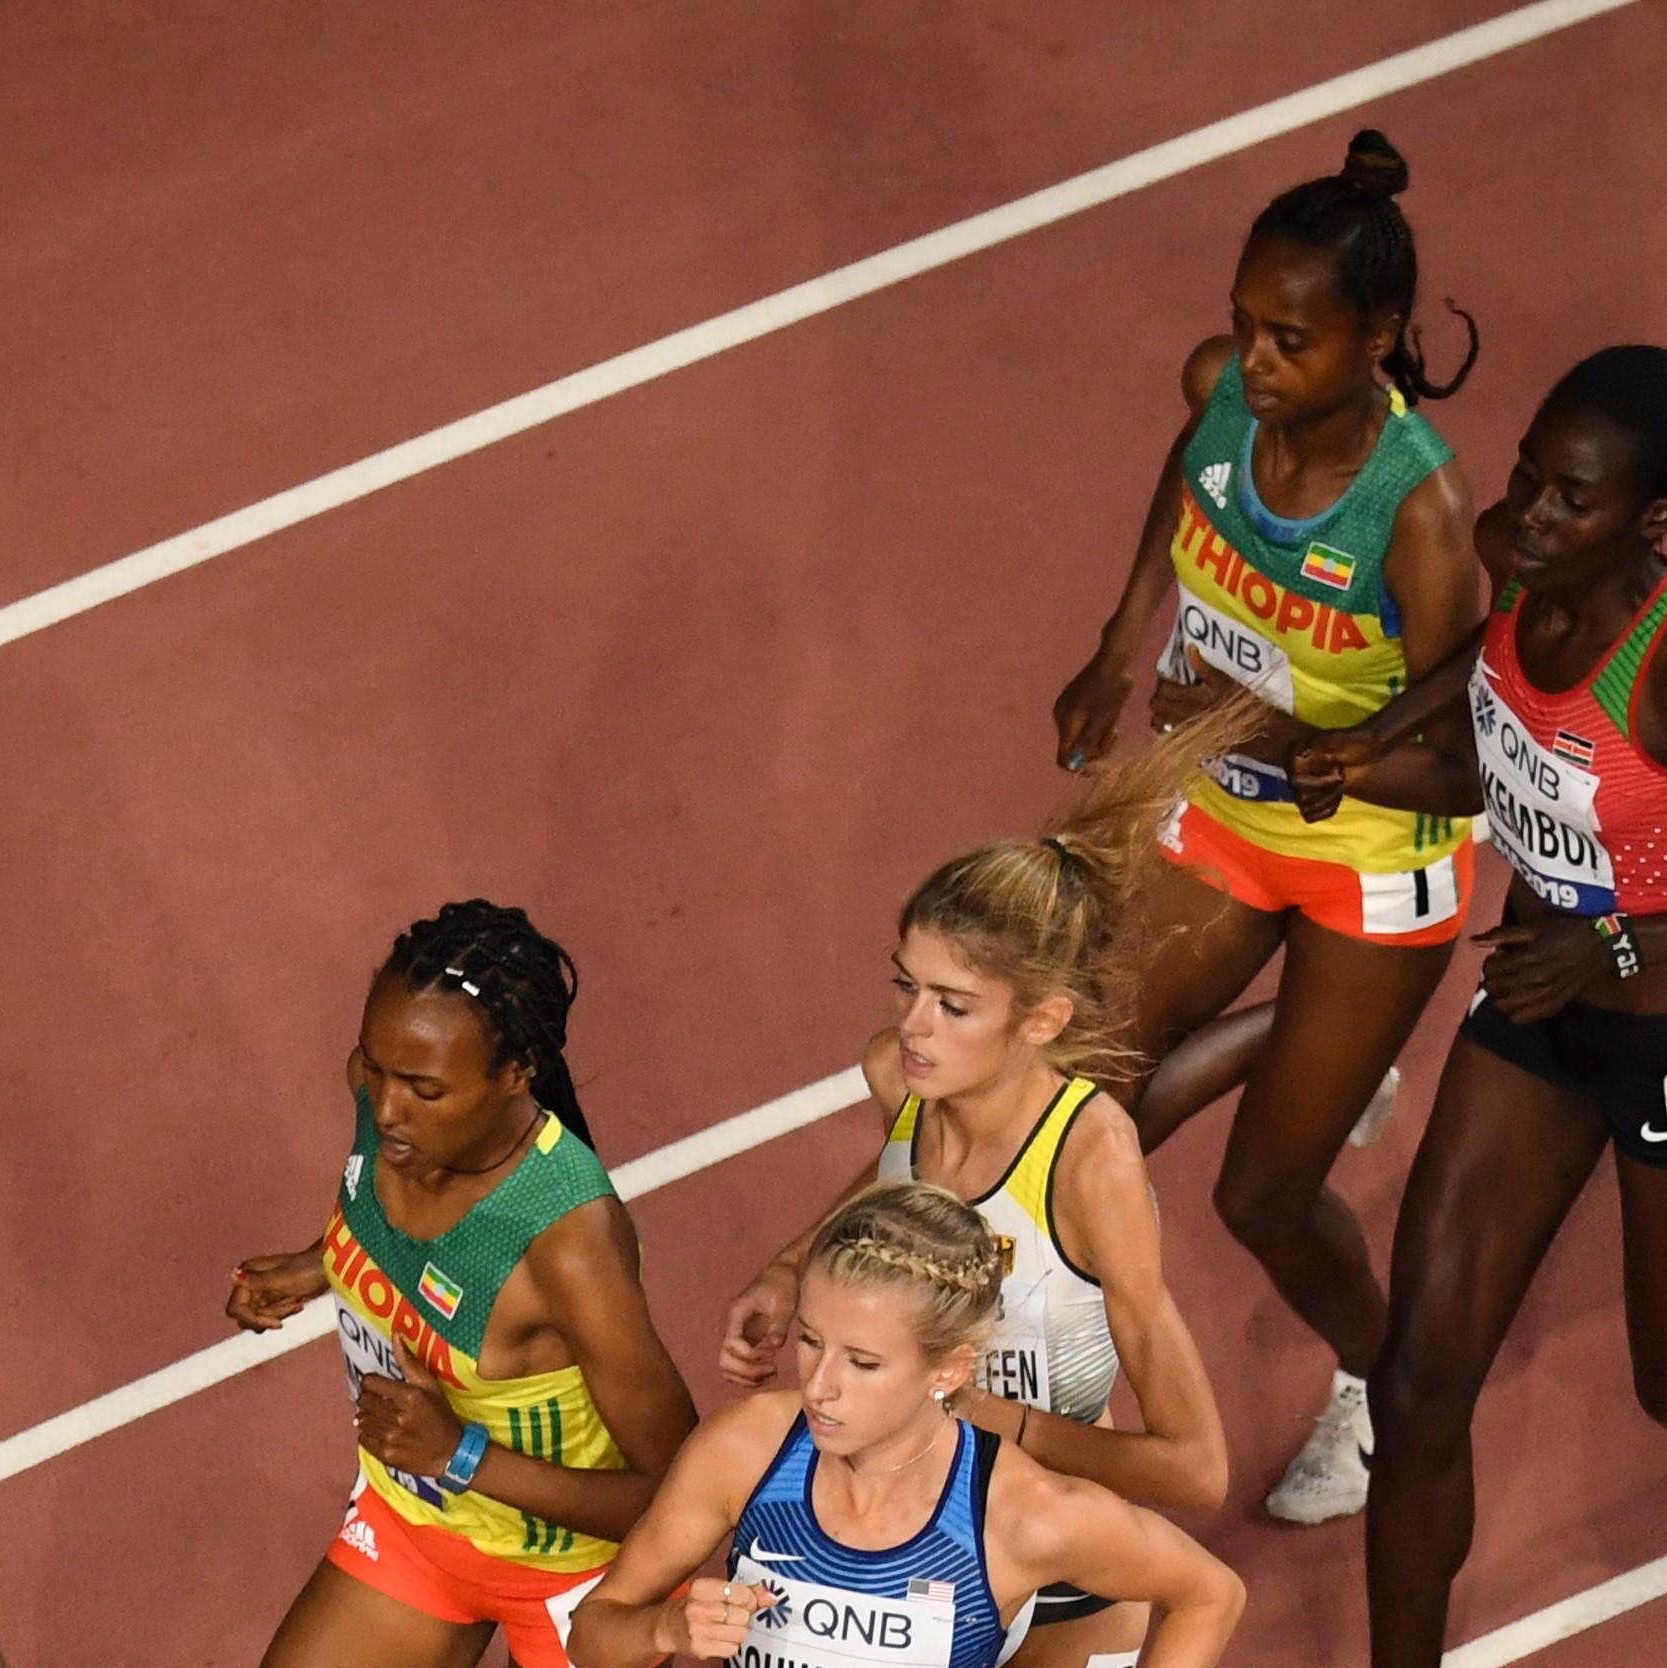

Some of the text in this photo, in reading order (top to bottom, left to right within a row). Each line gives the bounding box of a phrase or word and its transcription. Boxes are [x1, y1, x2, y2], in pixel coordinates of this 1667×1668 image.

[1185, 605, 1262, 673] QNB
[1501, 722, 1561, 801] QNB
[803, 1598, 912, 1650] QNB
